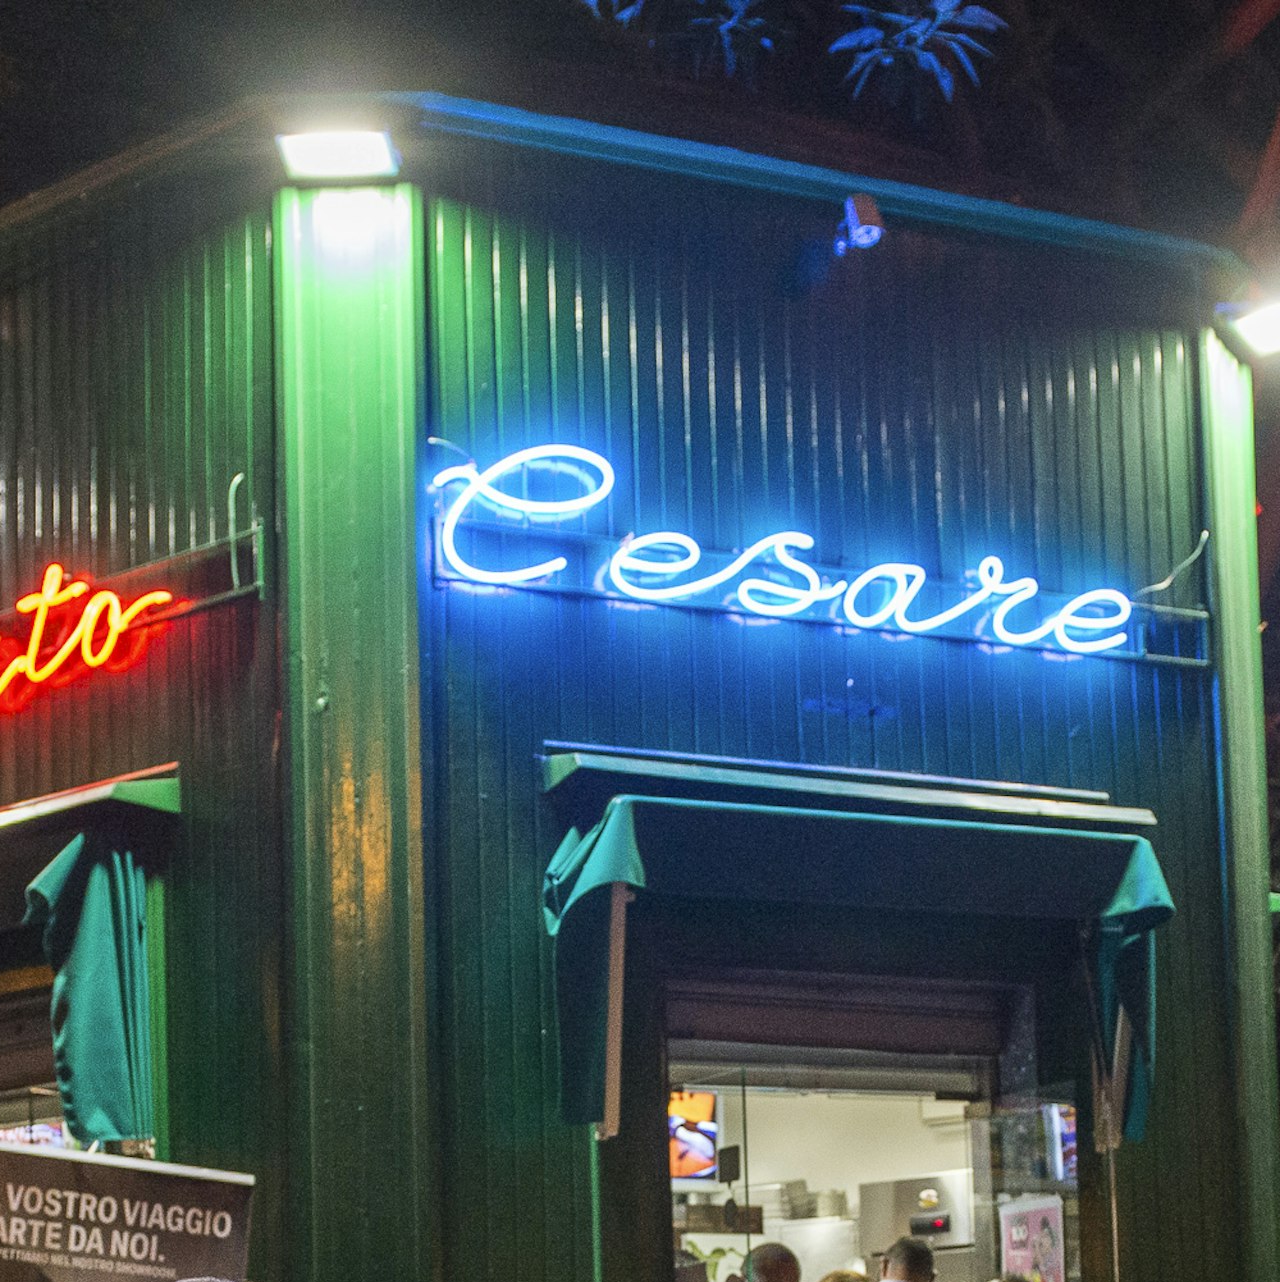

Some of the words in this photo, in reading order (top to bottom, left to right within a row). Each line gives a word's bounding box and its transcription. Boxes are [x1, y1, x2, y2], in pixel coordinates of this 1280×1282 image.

[432, 444, 1132, 653] Cesare
[6, 1182, 118, 1224] VOSTRO
[123, 1199, 233, 1239] VIAGGIO
[68, 1224, 105, 1256] DA
[110, 1229, 166, 1262] NOI.
